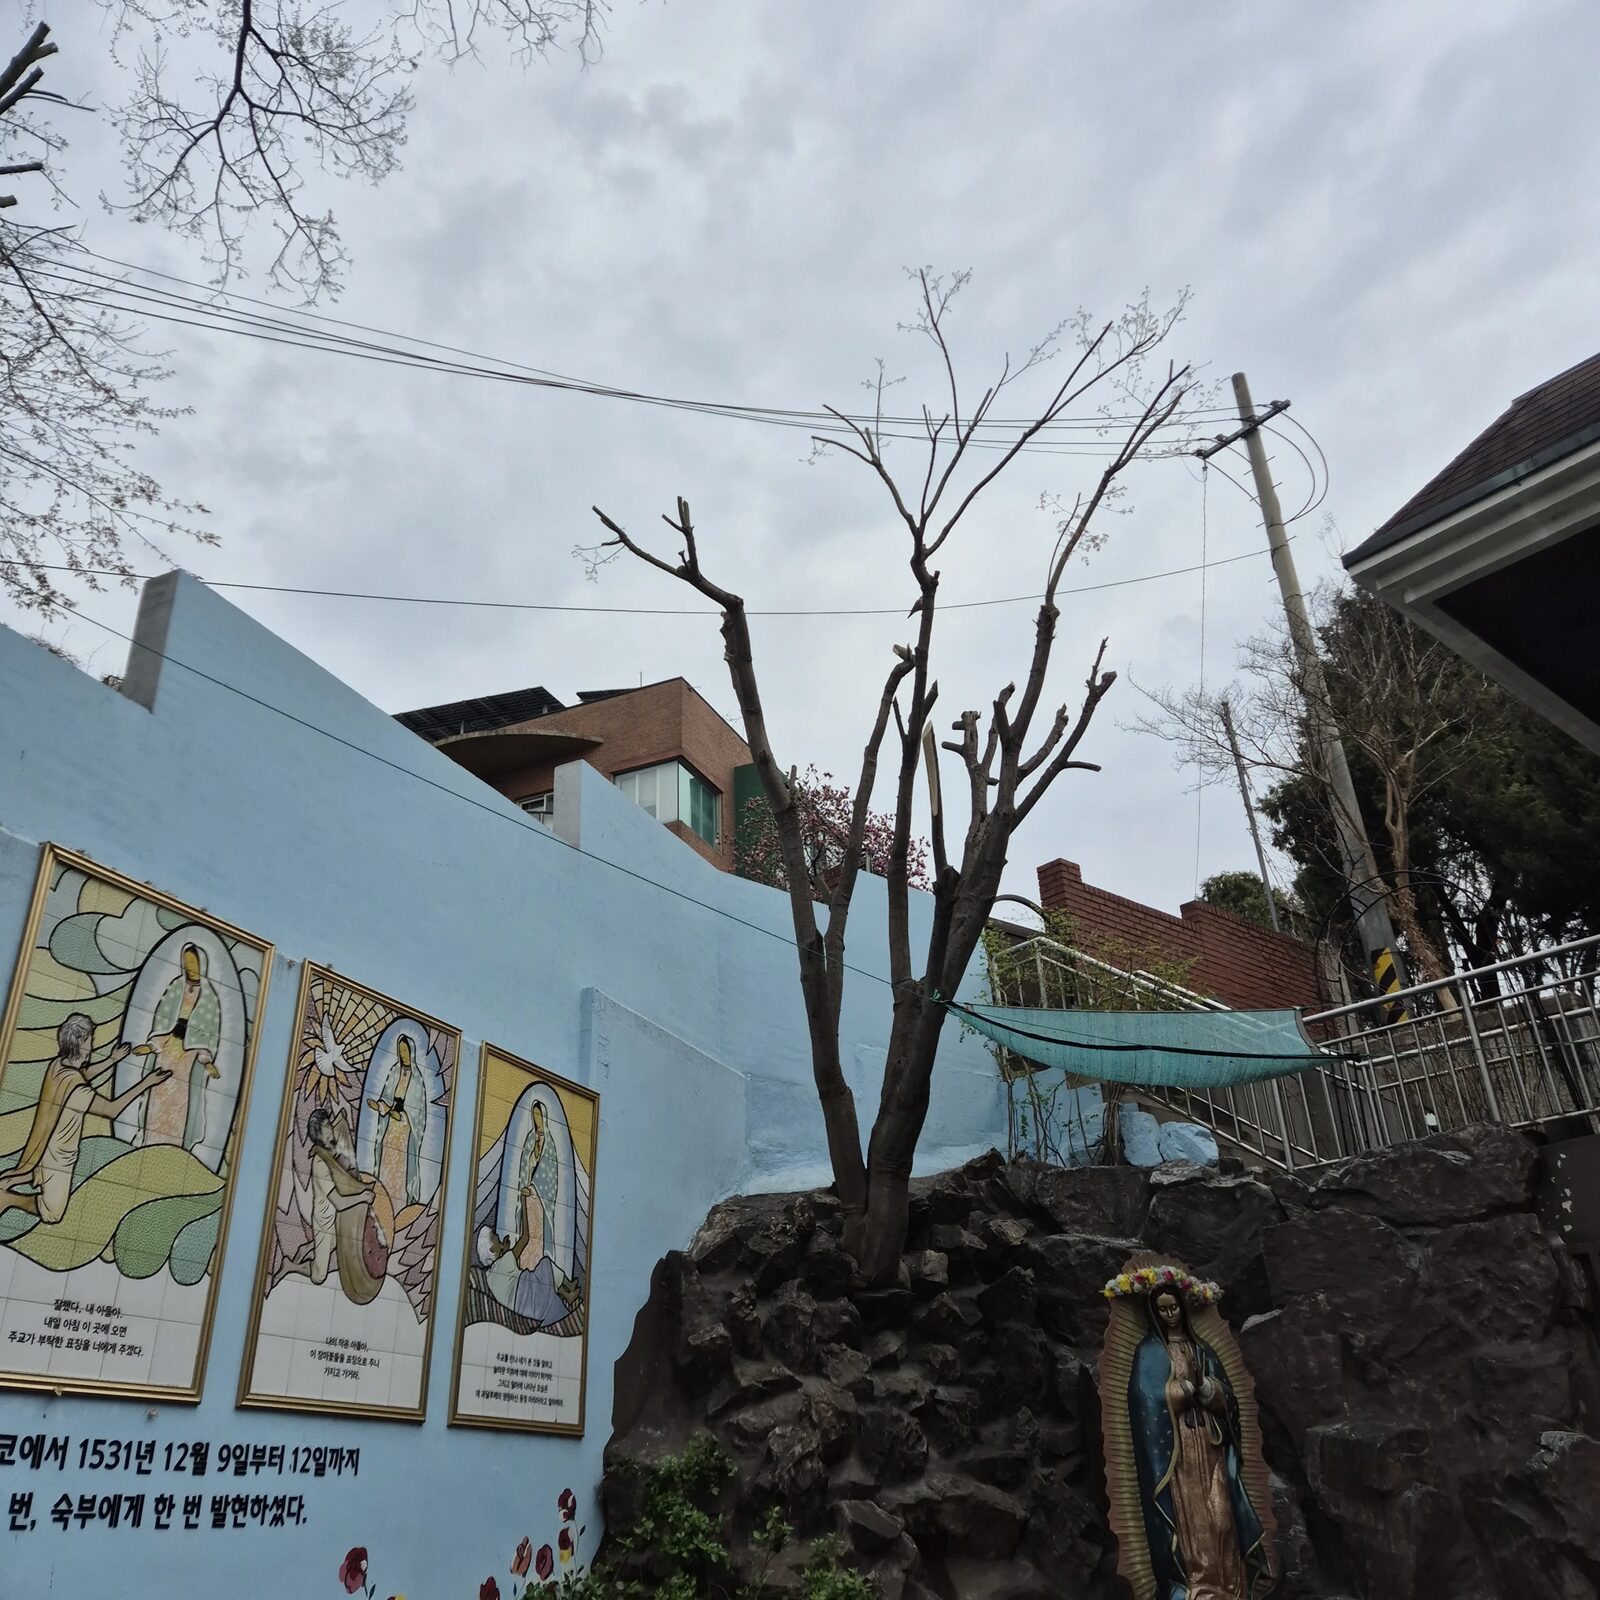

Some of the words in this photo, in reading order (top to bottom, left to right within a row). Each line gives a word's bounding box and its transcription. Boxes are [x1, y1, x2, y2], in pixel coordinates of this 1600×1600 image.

[54, 1299, 82, 1314] 잘했다,
[86, 1304, 95, 1314] 내
[97, 1305, 123, 1319] 아들아.
[44, 1317, 61, 1329] 내일
[63, 1320, 80, 1332] 아침
[83, 1322, 91, 1333] 이
[93, 1323, 110, 1335] 곳에
[111, 1326, 128, 1338] 오면
[8, 1331, 35, 1345] 주교가
[37, 1334, 64, 1348] 부탁한
[65, 1339, 91, 1352] 표징을
[93, 1342, 118, 1354] 너에게
[118, 1345, 144, 1357] 주겠다.
[326, 1336, 337, 1347] 나의
[338, 1338, 349, 1349] 작은
[310, 1349, 316, 1359] 이
[346, 1355, 367, 1366] 표징으로
[369, 1358, 380, 1368] 주니
[324, 1367, 340, 1377] 가지고
[0, 1434, 69, 1470] 코에서
[78, 1439, 156, 1476] 1531년
[164, 1442, 209, 1476] 12월
[218, 1444, 285, 1476] 9일부터
[291, 1446, 360, 1478] 12일까지
[8, 1492, 37, 1531] 번,
[51, 1493, 145, 1531] 숙부에게
[154, 1494, 175, 1529] 한
[183, 1494, 202, 1529] 번
[211, 1494, 308, 1529] 발현하셨다.
